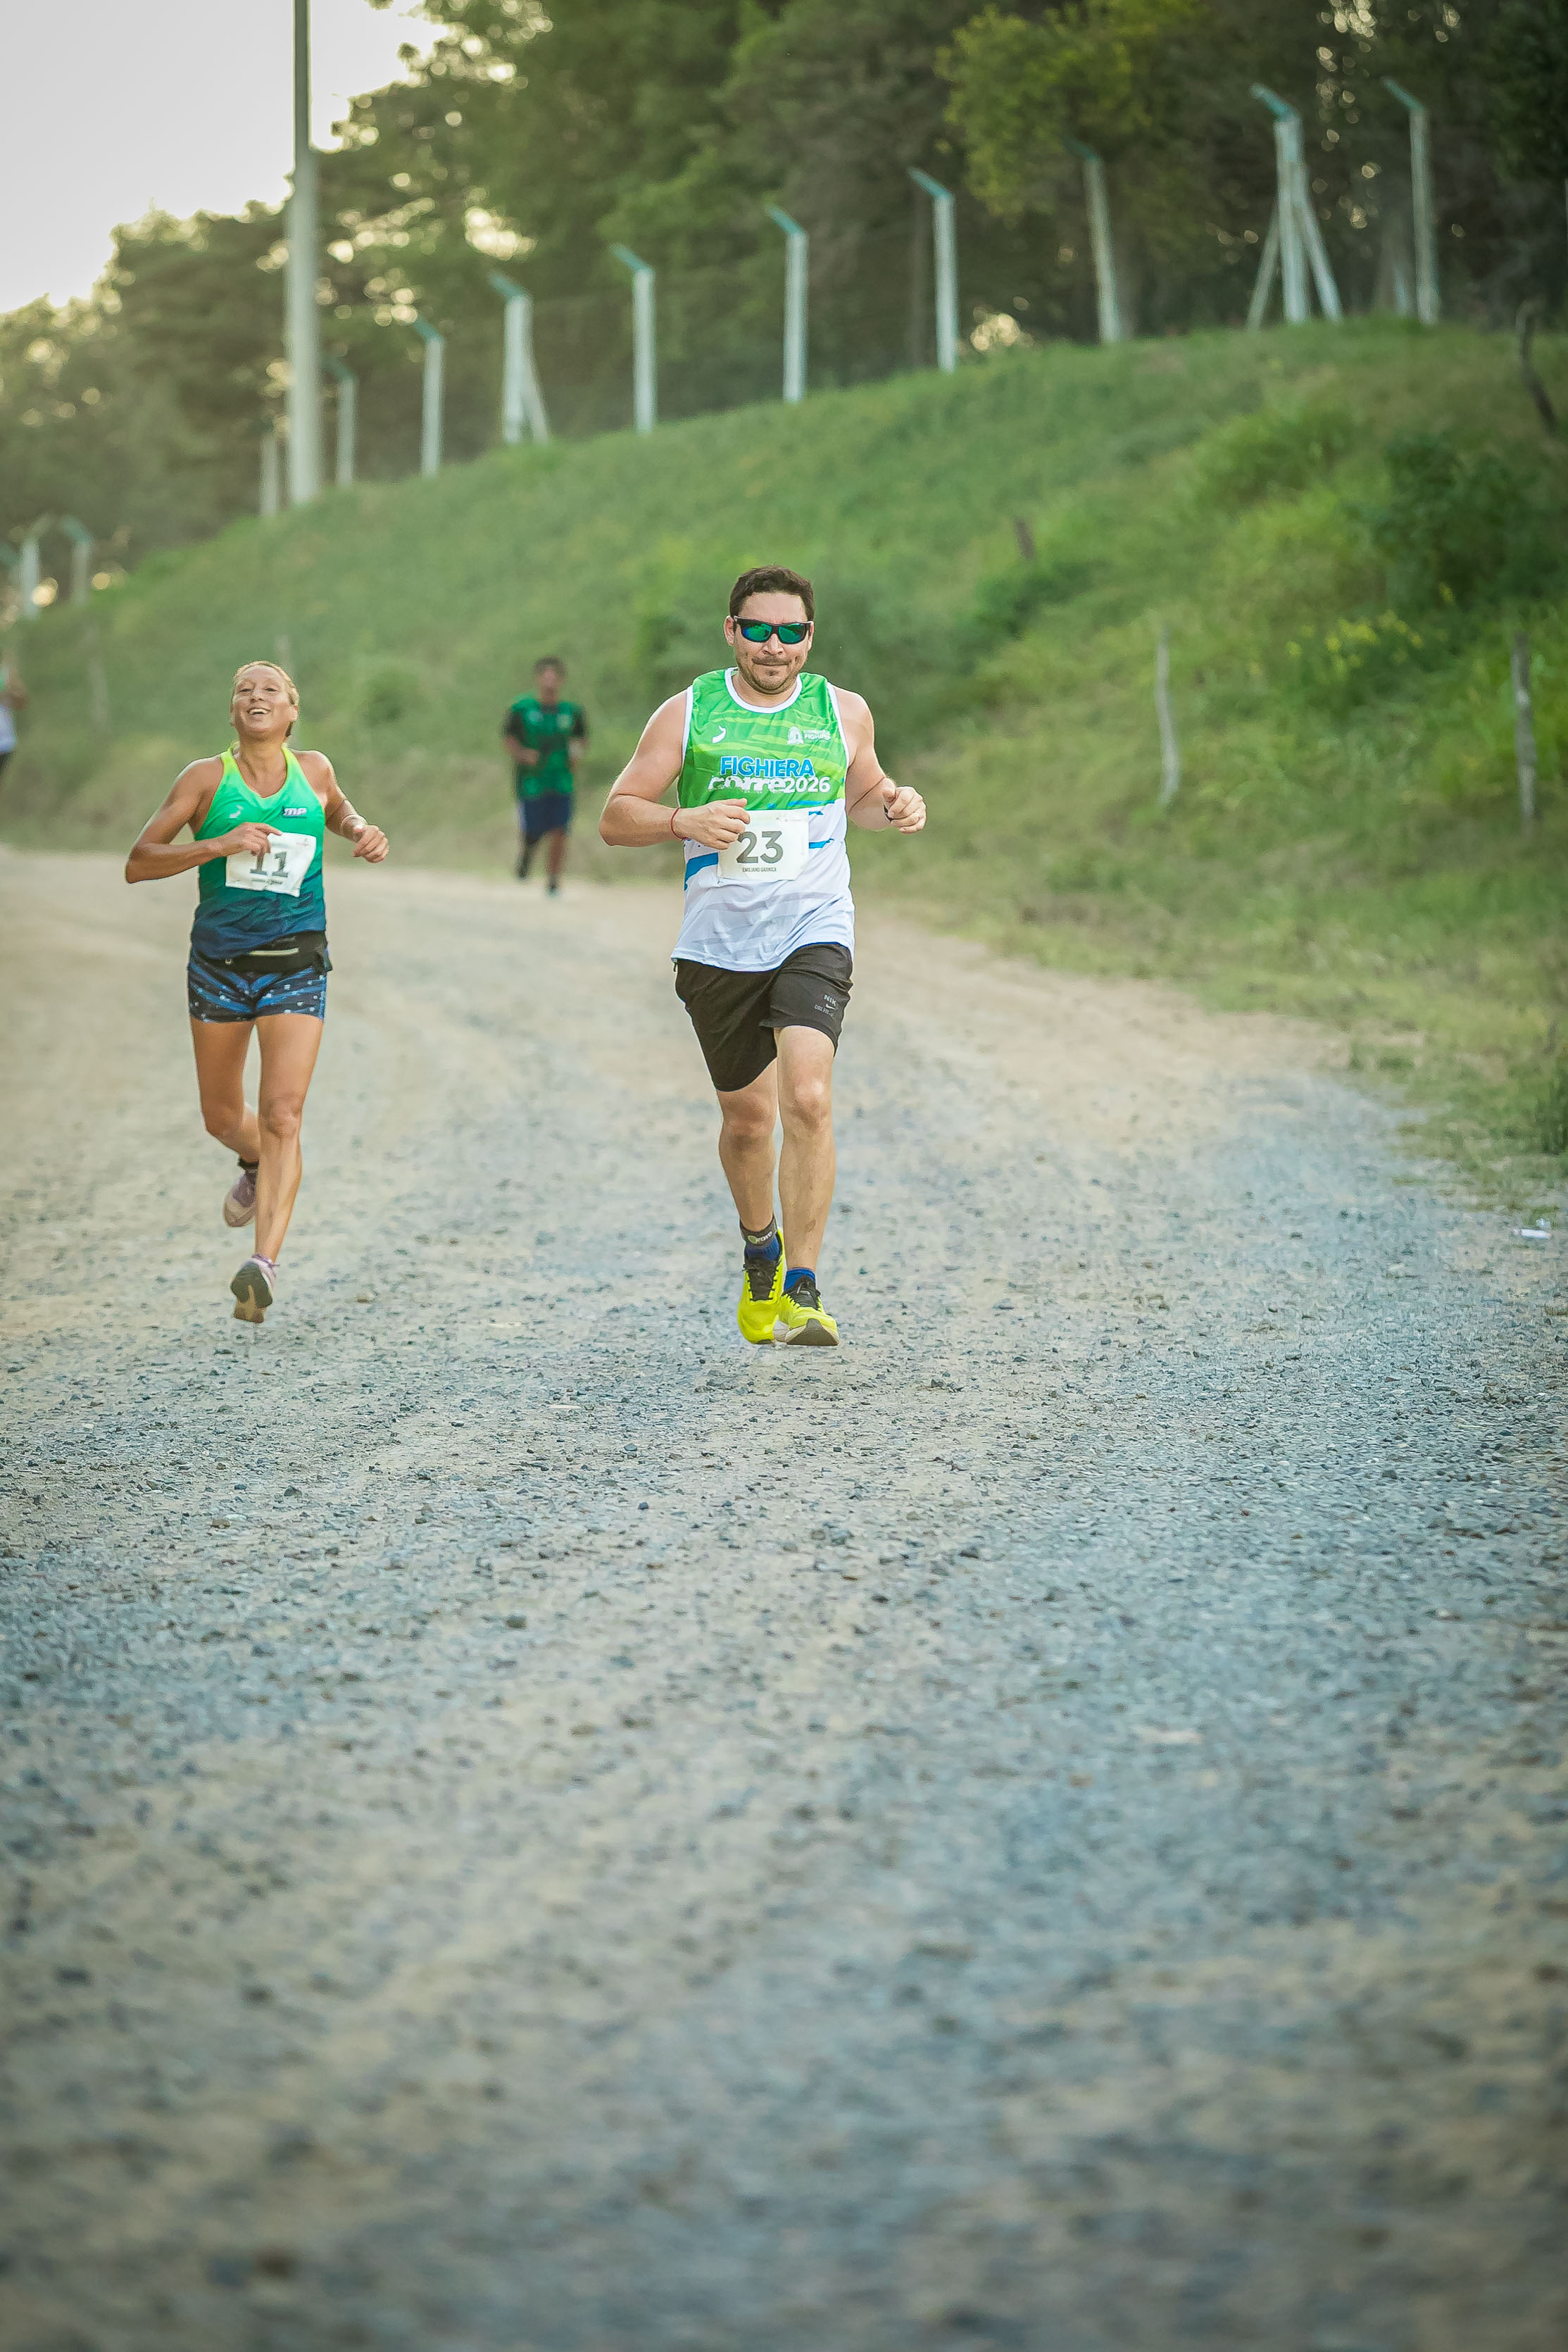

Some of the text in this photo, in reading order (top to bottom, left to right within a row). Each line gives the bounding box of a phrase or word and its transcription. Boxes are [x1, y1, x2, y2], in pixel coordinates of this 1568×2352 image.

[720, 756, 816, 778] FIGHIERA
[736, 831, 783, 864] 23
[249, 851, 289, 878] 11
[824, 994, 839, 1007] NIK
